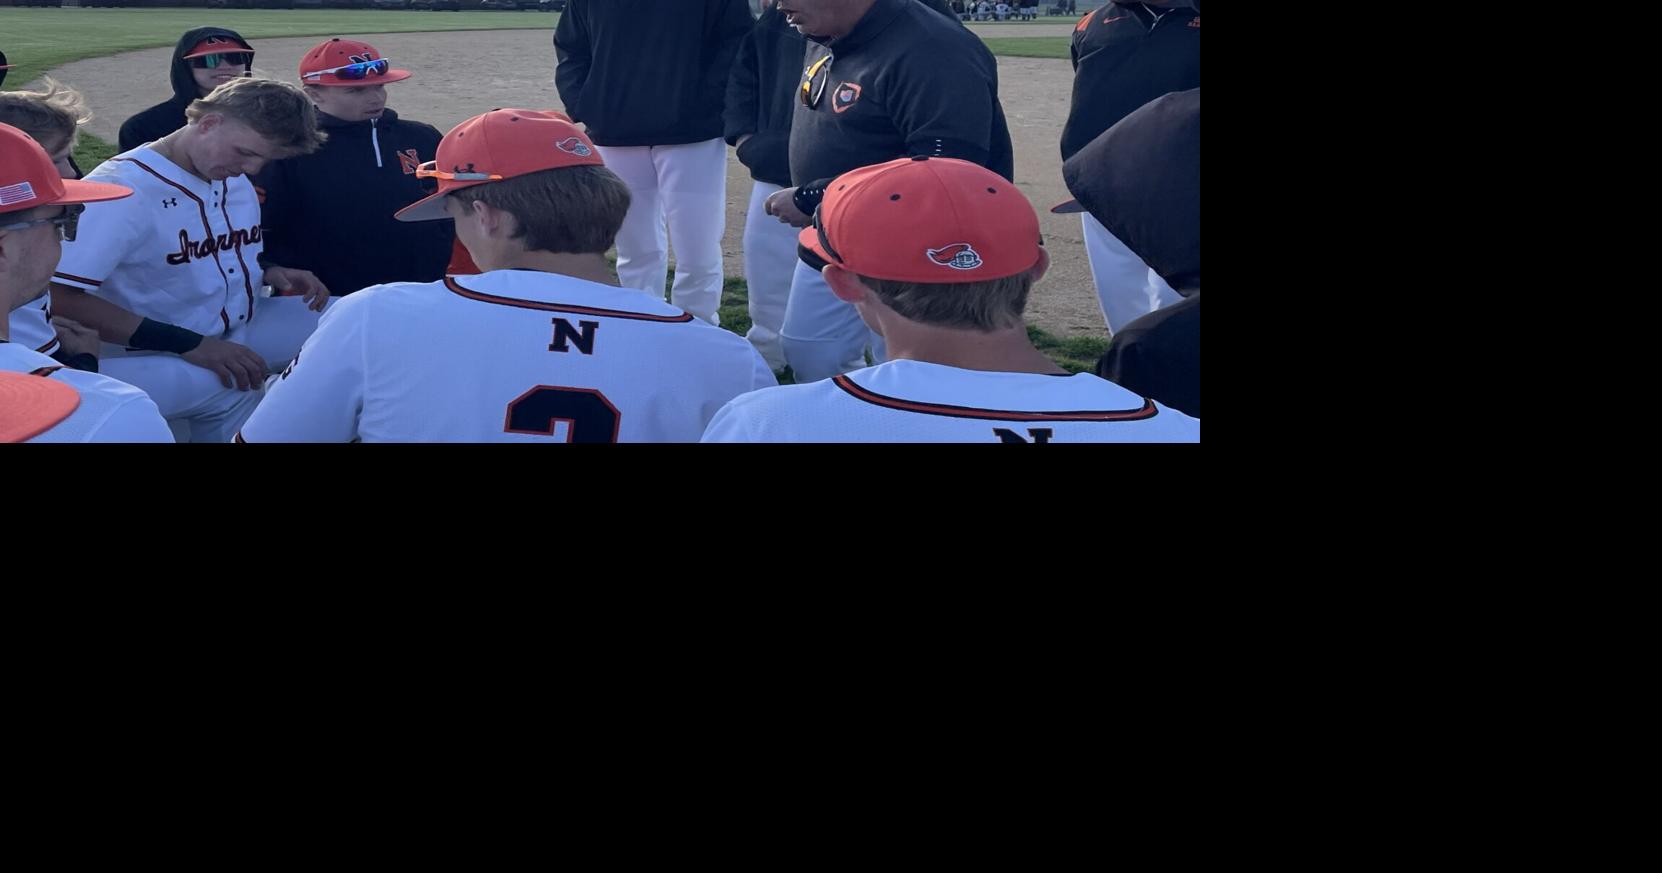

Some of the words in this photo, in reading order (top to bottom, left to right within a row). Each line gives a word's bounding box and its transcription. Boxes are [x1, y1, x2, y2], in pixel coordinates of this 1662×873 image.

[396, 148, 421, 175] N
[166, 225, 261, 265] Ironme
[548, 317, 599, 355] N
